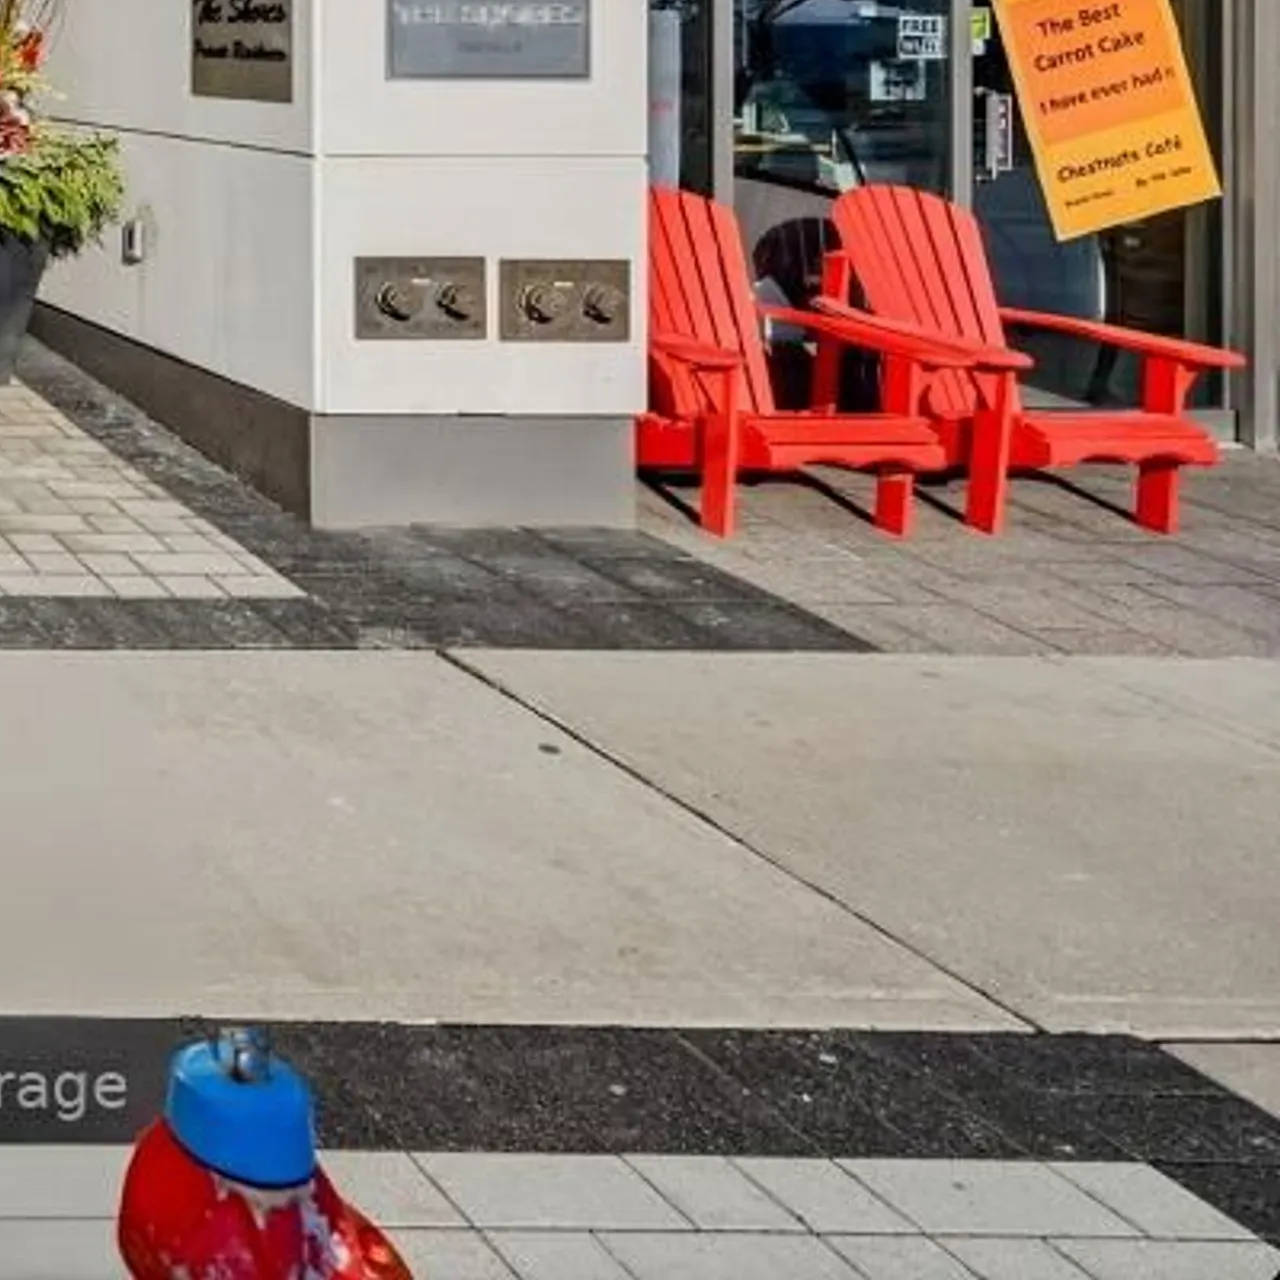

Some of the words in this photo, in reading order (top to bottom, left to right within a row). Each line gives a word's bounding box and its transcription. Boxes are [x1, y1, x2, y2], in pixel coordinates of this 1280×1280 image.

[1037, 18, 1074, 36] The
[1078, 3, 1122, 26] Best
[1033, 44, 1093, 72] Carrot
[1097, 31, 1145, 53] Cake
[1050, 91, 1087, 111] have
[1091, 79, 1128, 100] ever
